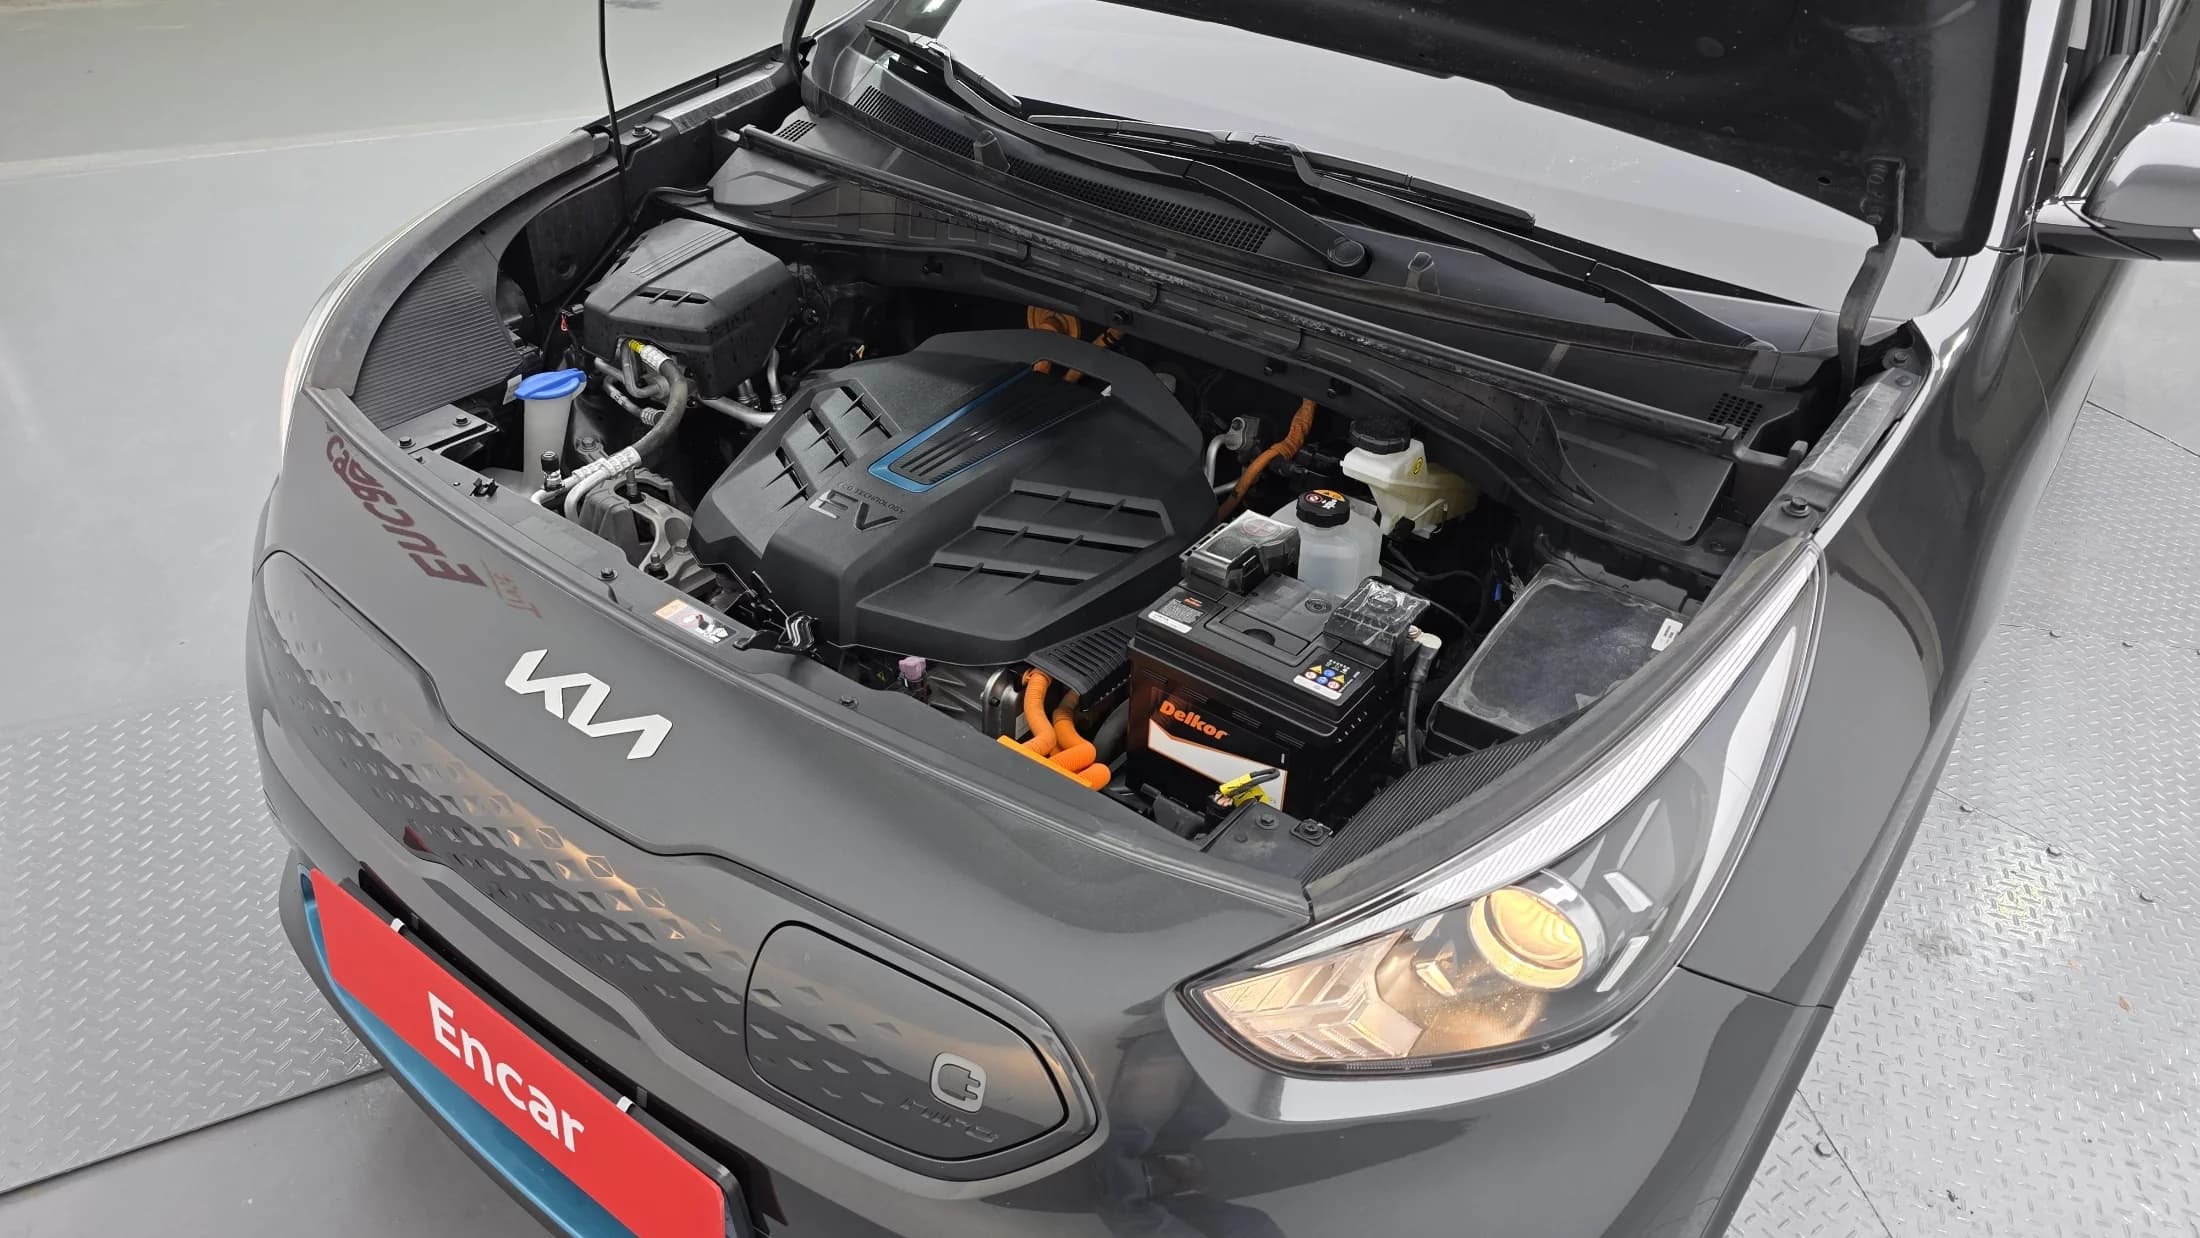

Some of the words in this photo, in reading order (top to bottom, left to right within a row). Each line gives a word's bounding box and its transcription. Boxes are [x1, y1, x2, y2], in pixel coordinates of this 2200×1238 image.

[808, 488, 899, 532] EV
[1159, 699, 1229, 740] Delkor
[426, 990, 586, 1153] Encar
